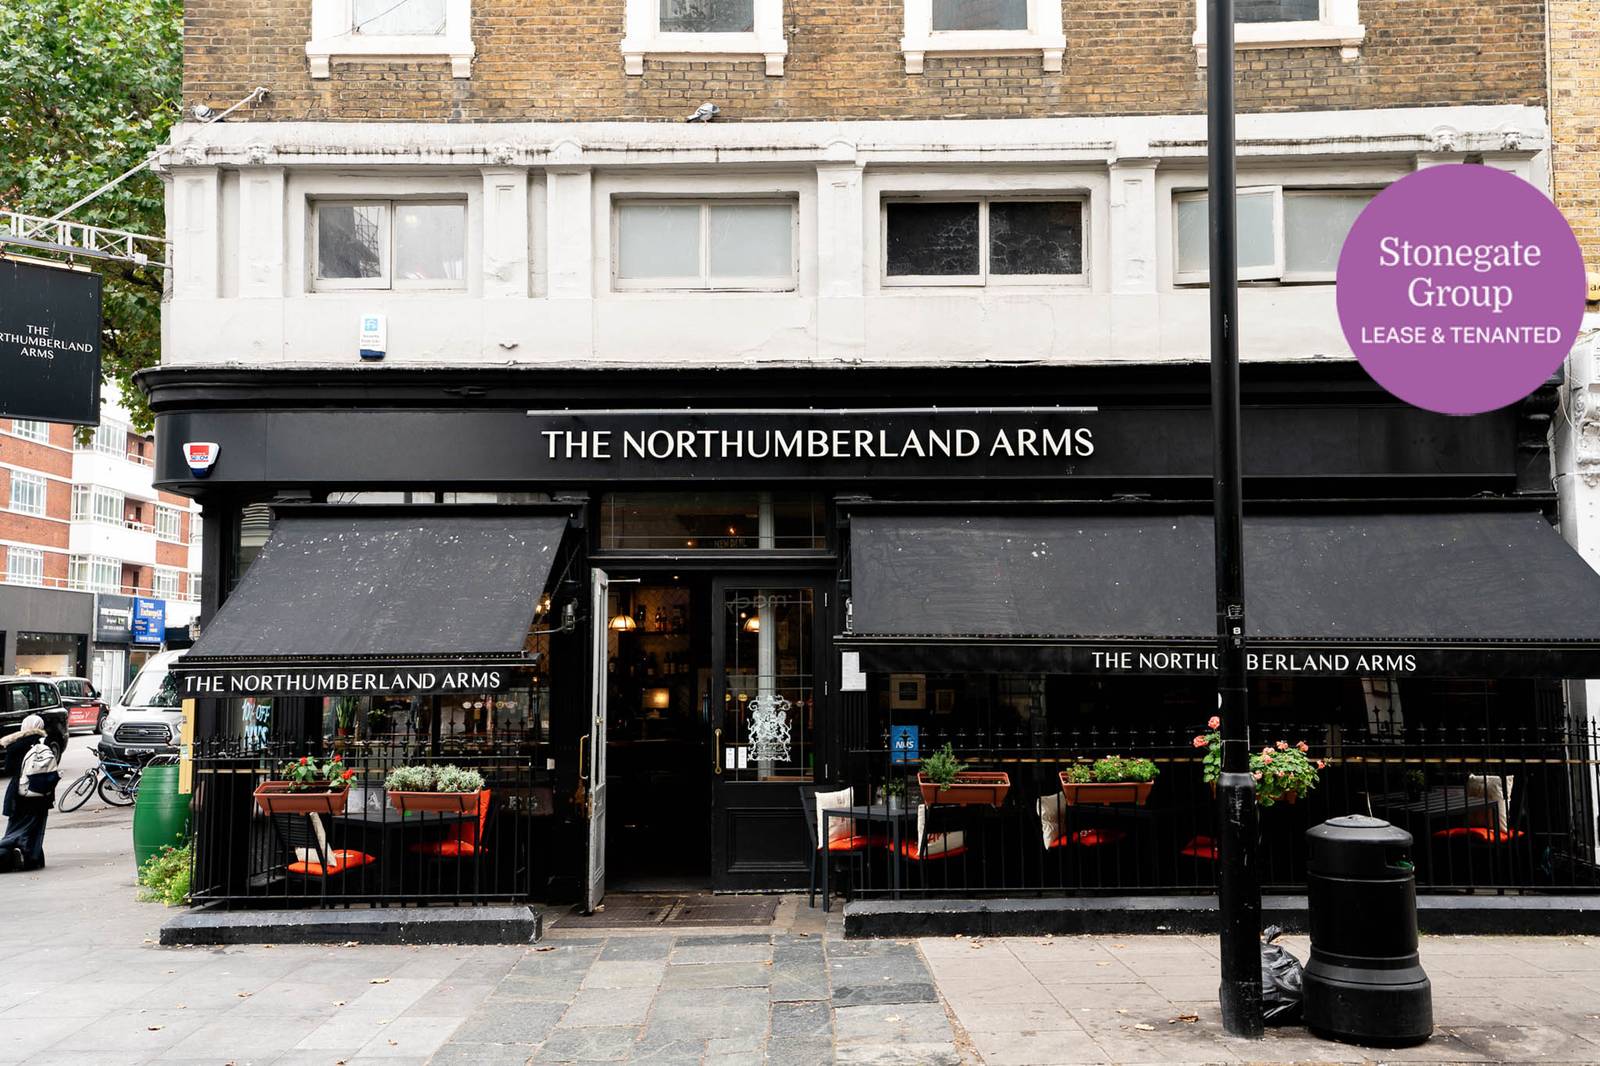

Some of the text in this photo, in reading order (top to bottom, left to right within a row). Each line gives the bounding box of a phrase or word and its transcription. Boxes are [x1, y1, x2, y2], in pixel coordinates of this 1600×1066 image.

[26, 324, 50, 337] THE
[20, 346, 55, 360] ARMS
[541, 428, 1095, 459] THE NORTHUMBERLAND ARMS
[1091, 652, 1417, 671] THE NORTHUBERLAND ARMS
[184, 671, 501, 693] THE NORTHUMBERLAND ARMS
